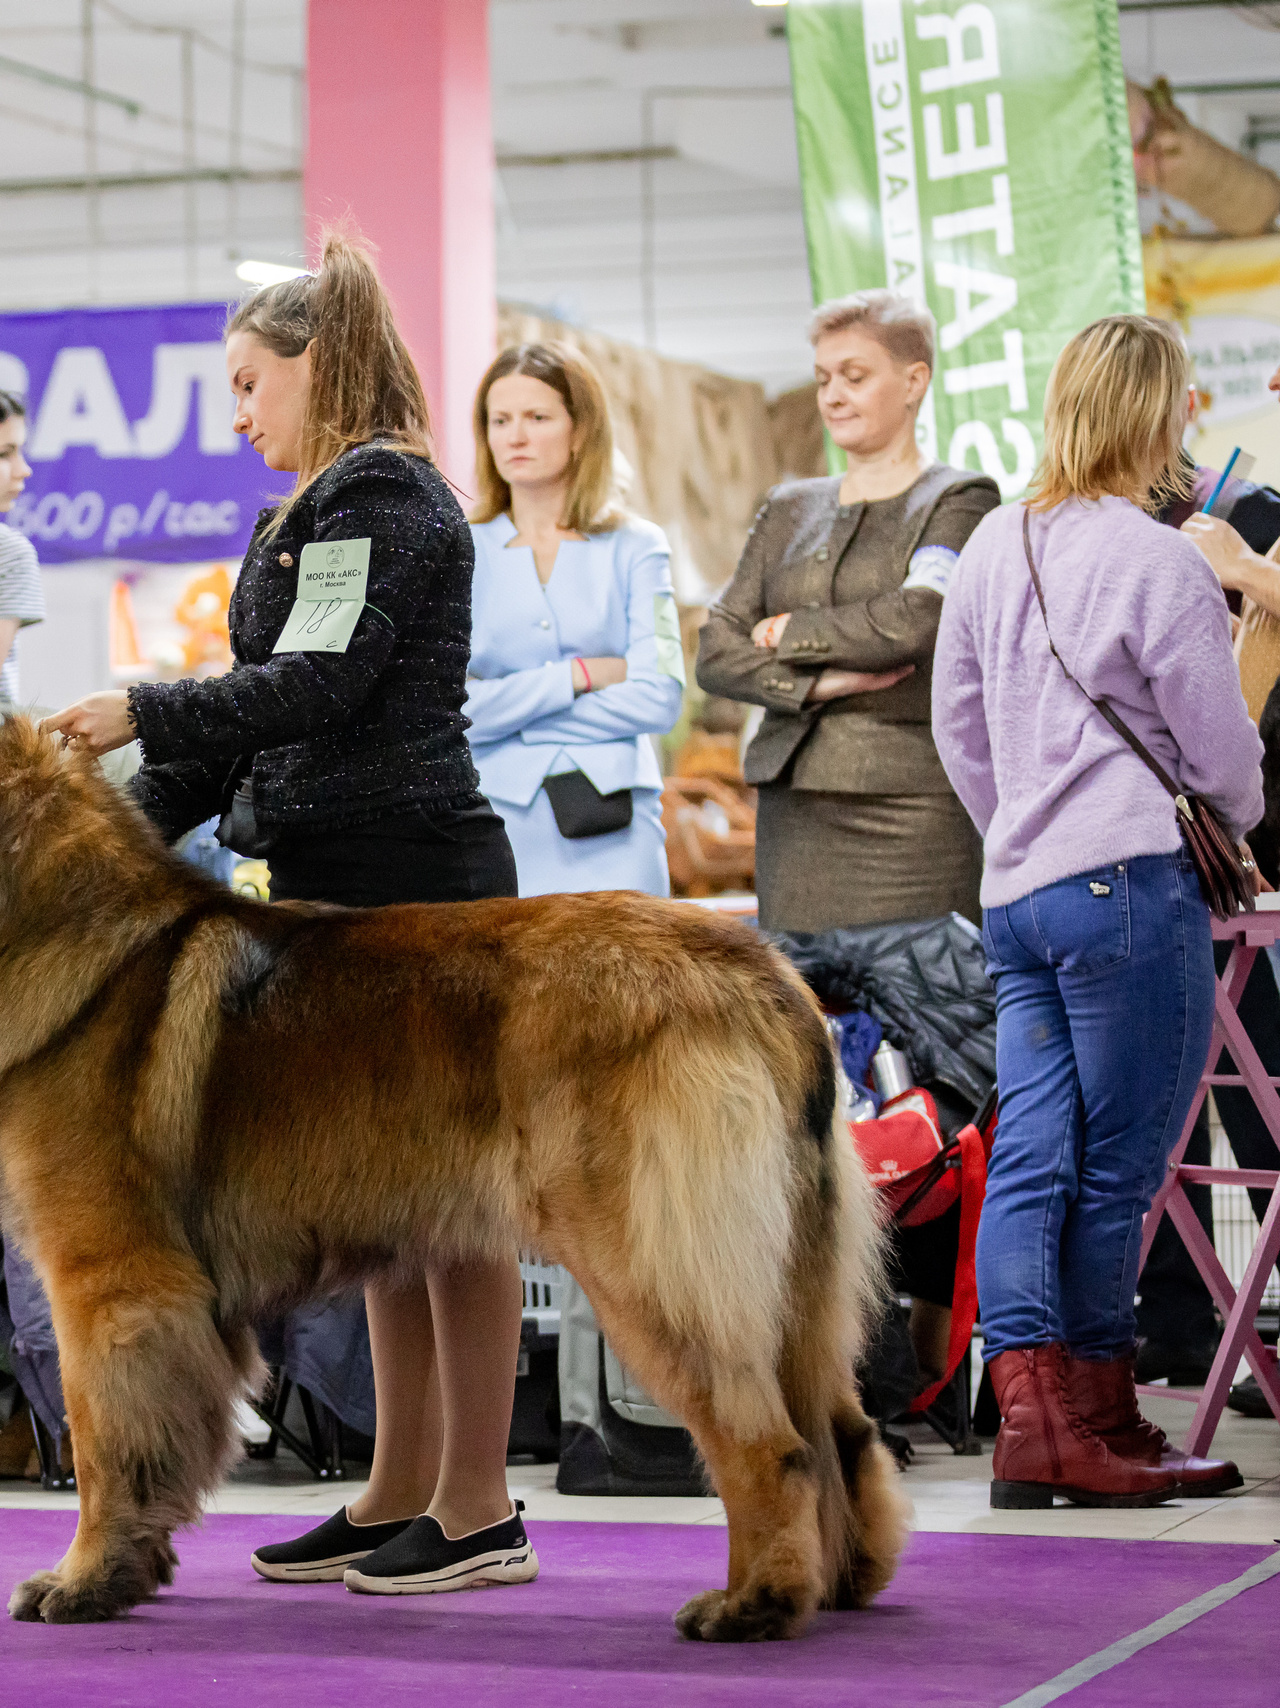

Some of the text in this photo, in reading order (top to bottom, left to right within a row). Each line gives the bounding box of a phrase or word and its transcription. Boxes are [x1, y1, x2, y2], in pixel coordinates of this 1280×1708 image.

[305, 568, 362, 582] МОО КК «АКС»
[325, 580, 346, 588] Москва
[296, 597, 342, 634] 18
